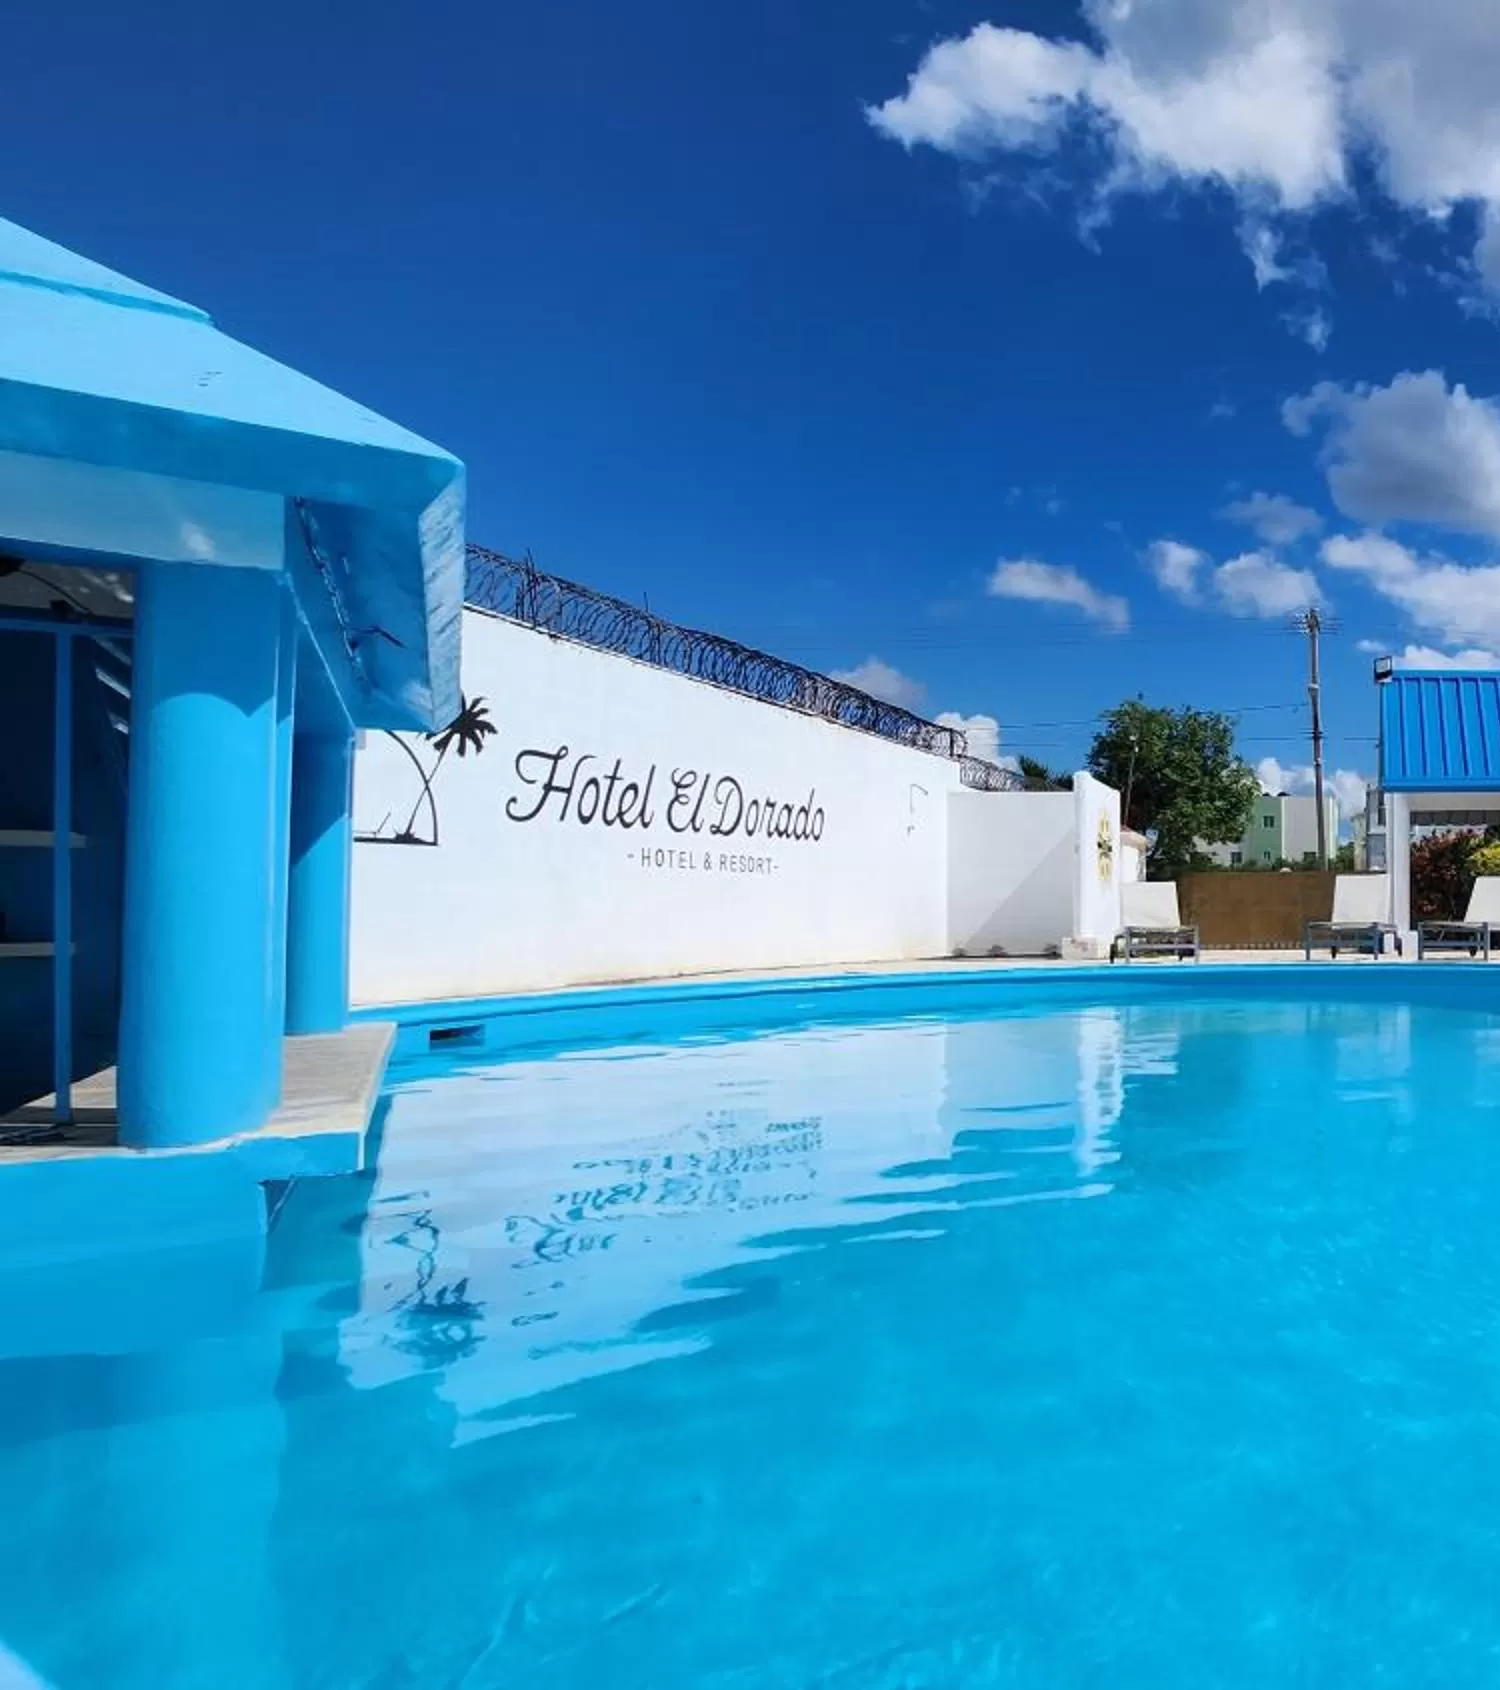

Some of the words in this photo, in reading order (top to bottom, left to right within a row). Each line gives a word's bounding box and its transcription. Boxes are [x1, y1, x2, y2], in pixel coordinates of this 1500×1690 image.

[505, 745, 657, 830] Hotel
[666, 768, 711, 834] El
[711, 775, 825, 843] Dorado
[641, 847, 696, 869] HOTEL
[703, 852, 712, 871] &
